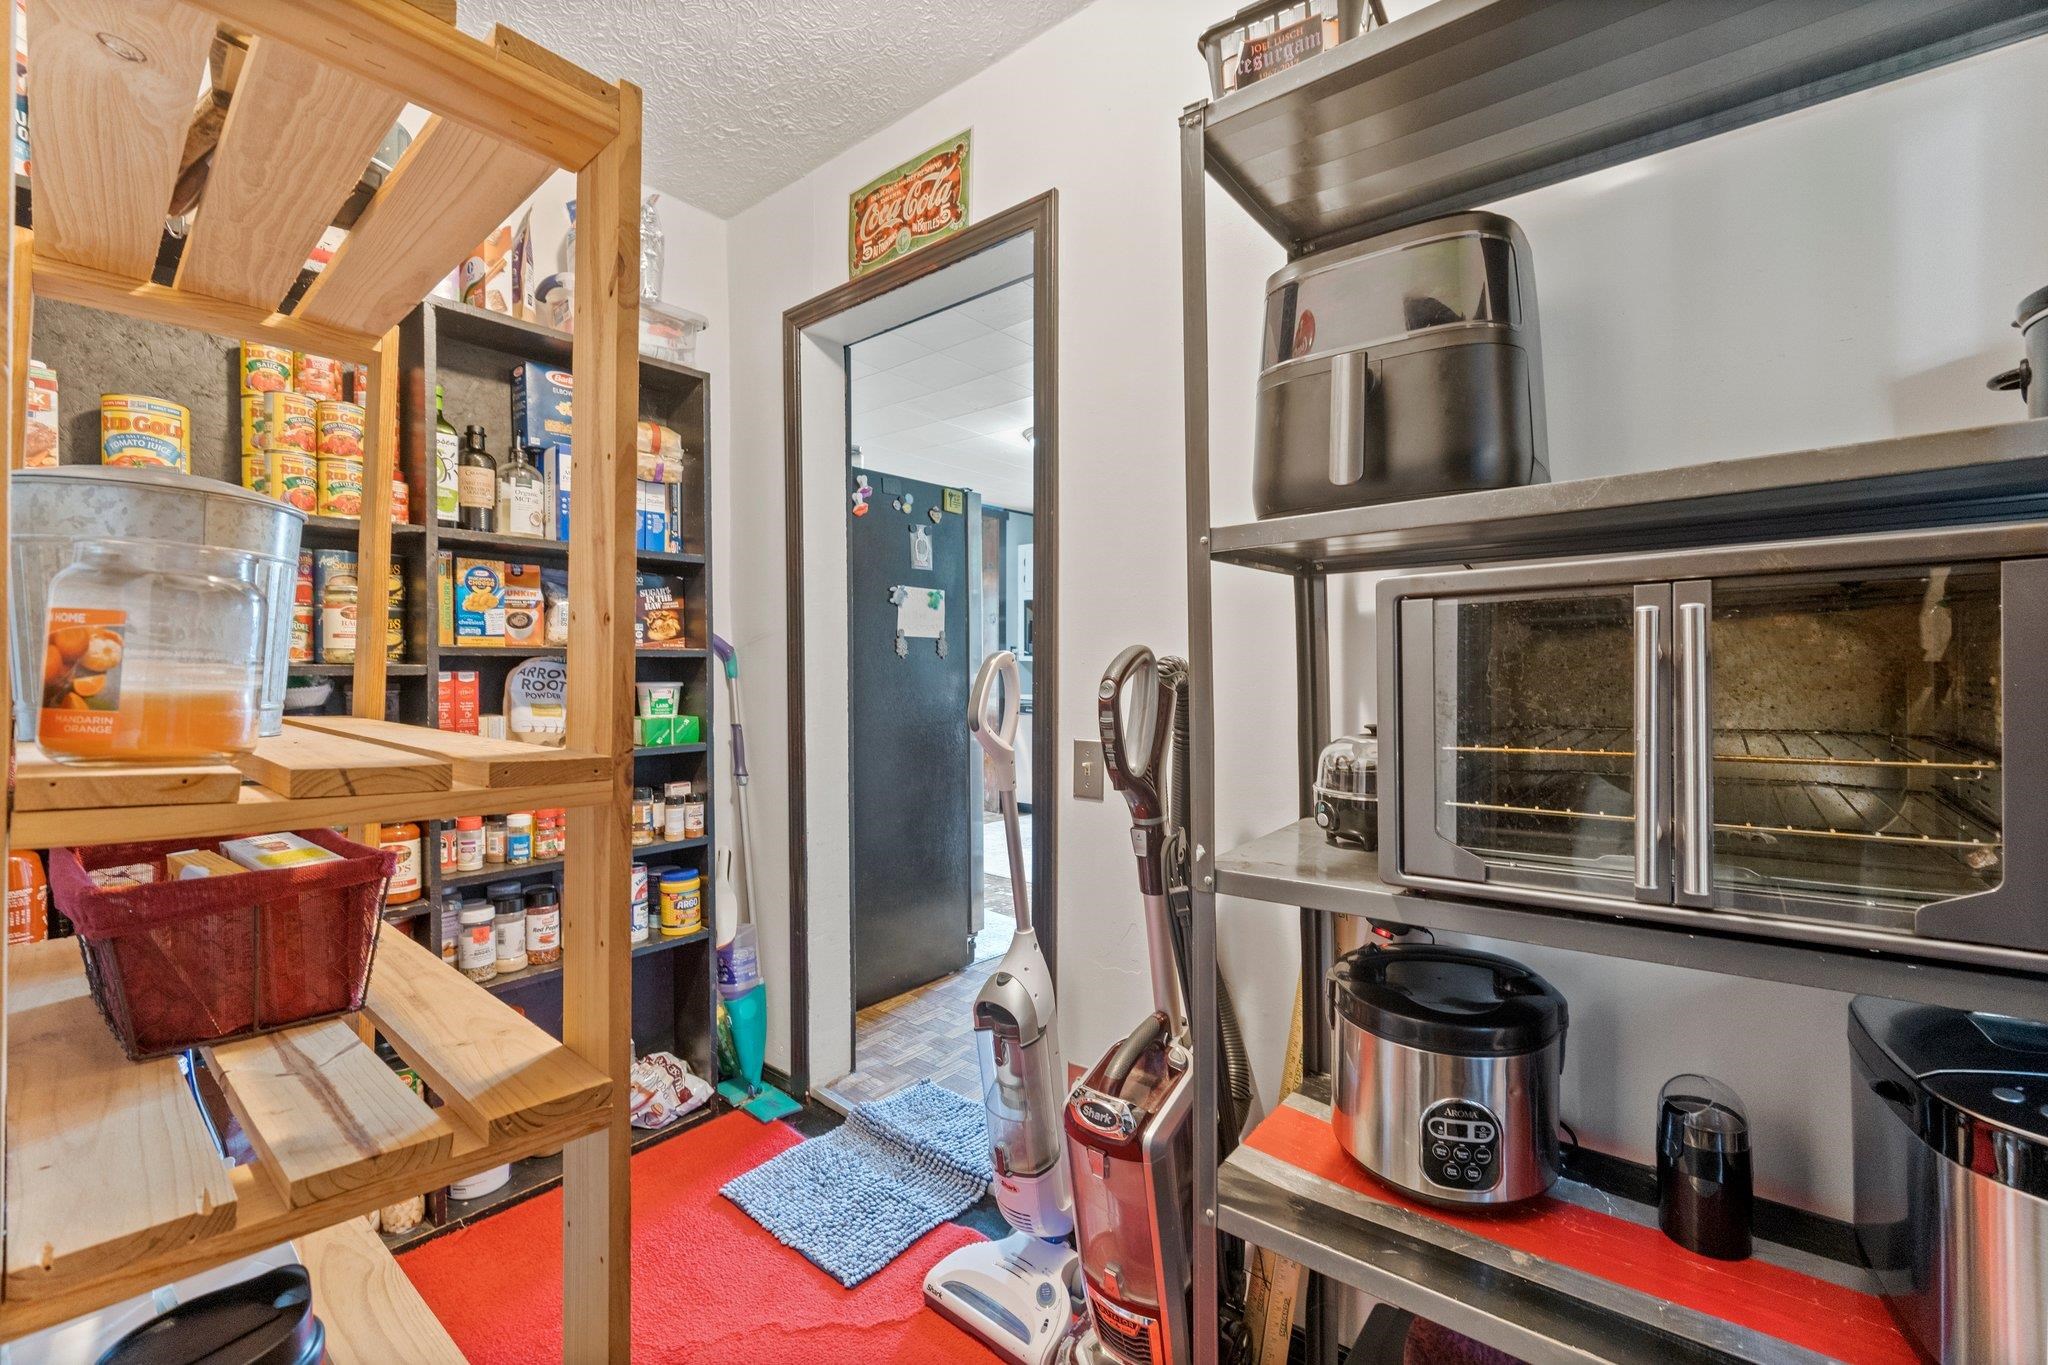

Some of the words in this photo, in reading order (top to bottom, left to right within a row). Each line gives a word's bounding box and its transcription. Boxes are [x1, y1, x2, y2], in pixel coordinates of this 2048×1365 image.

[1251, 40, 1270, 57] JOEL
[1274, 26, 1304, 46] LUSCH
[1238, 31, 1321, 75] resurgam
[256, 361, 283, 373] SAUCE
[132, 416, 183, 439] GOLD
[109, 439, 145, 450] TOMATO
[147, 441, 172, 455] JUICE
[640, 587, 669, 597] SUGAR
[644, 601, 662, 610] RAW
[55, 613, 86, 623] HOME
[521, 678, 566, 692] ROOT
[525, 692, 561, 700] POWDER
[55, 715, 114, 725] MANDARIN
[64, 725, 112, 734] ORANGE
[677, 897, 698, 909] ARGO
[1083, 1104, 1112, 1125] Shark
[1444, 1107, 1478, 1119] AROMA
[1001, 1179, 1018, 1194] Shark
[927, 1284, 942, 1300] Shark
